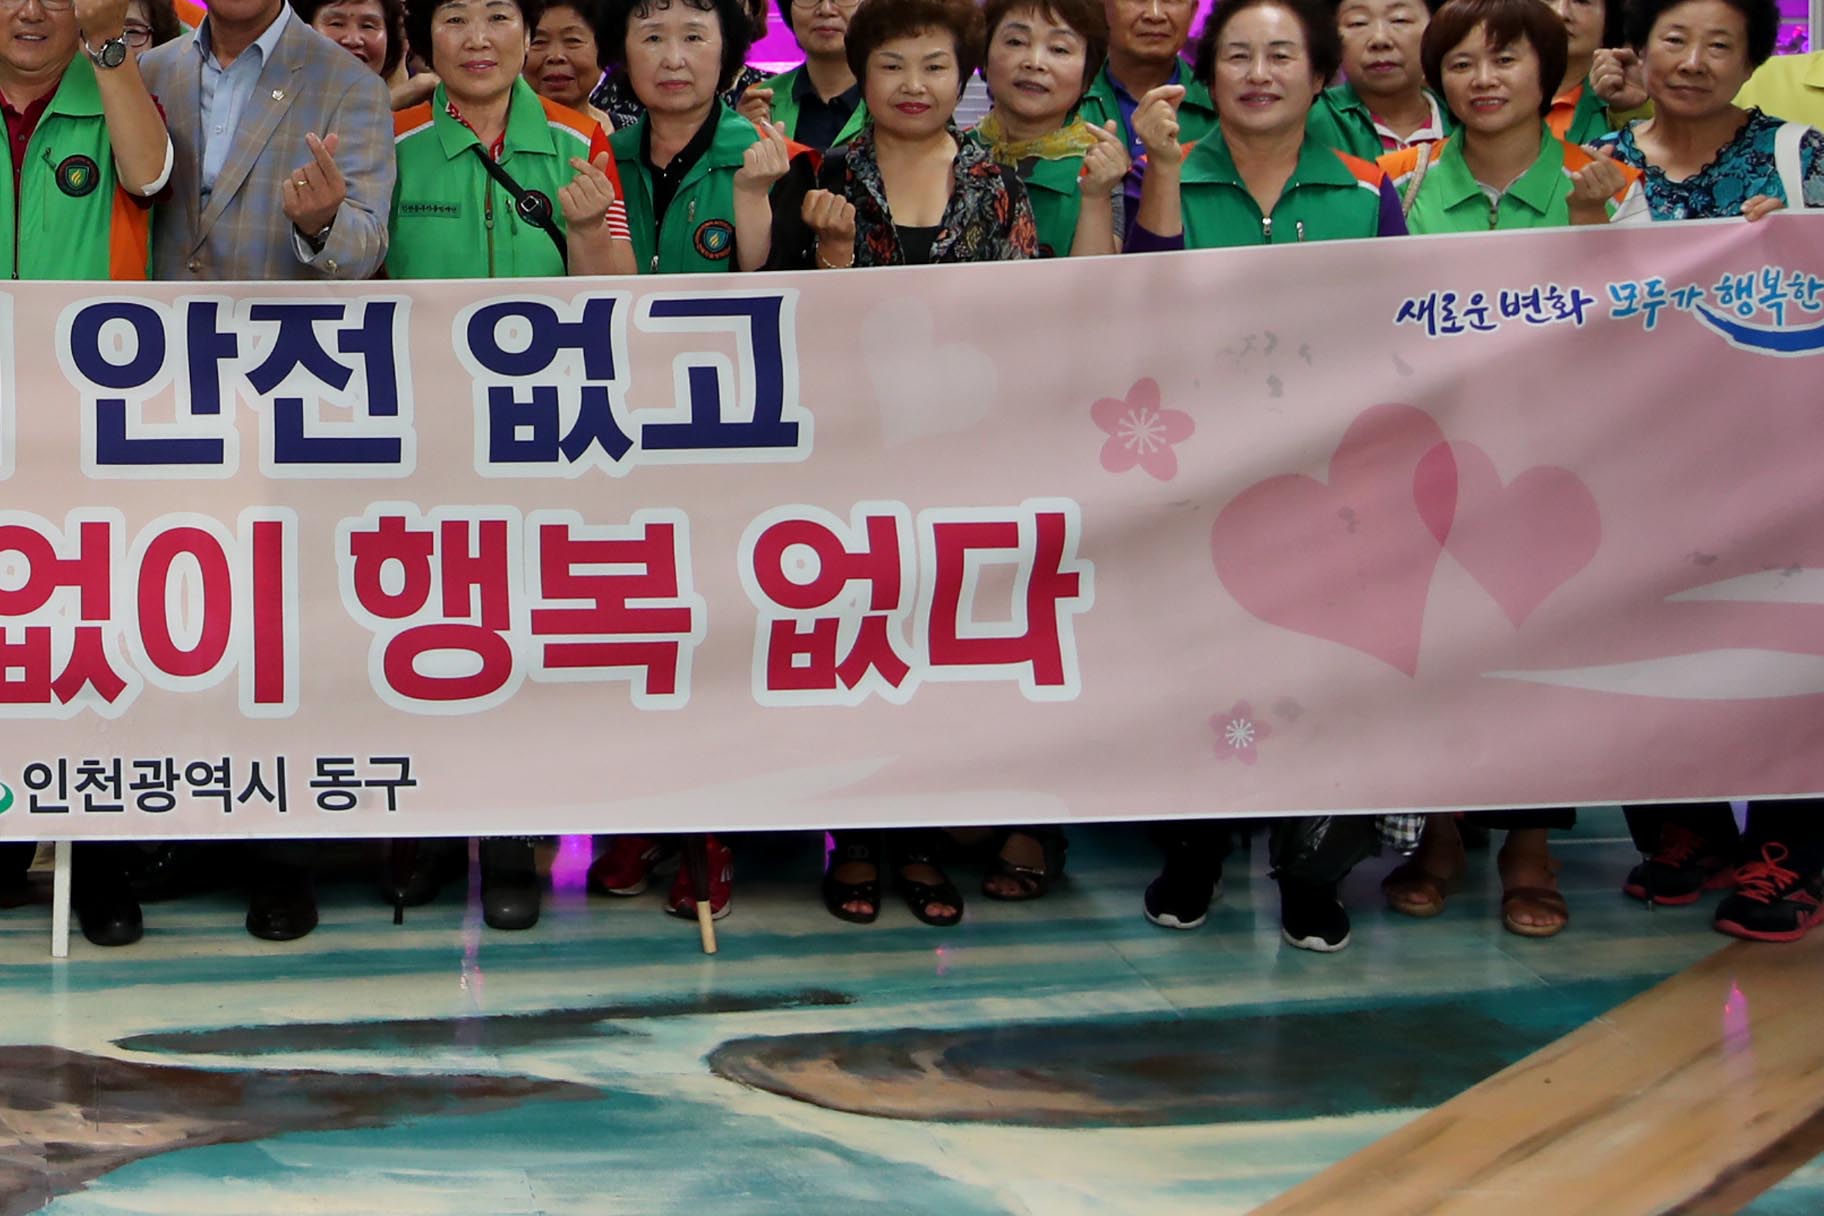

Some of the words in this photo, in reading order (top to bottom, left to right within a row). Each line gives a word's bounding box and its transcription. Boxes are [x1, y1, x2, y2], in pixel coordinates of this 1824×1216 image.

[1395, 292, 1496, 335] 새로운
[1501, 285, 1594, 325] 변화
[1608, 279, 1703, 330] 모두가
[69, 301, 402, 465] 안전
[466, 295, 799, 463] 없고
[350, 516, 692, 700] 행복
[753, 512, 1079, 692] 없다
[23, 756, 288, 814] 인천광역시
[309, 756, 417, 812] 동구
